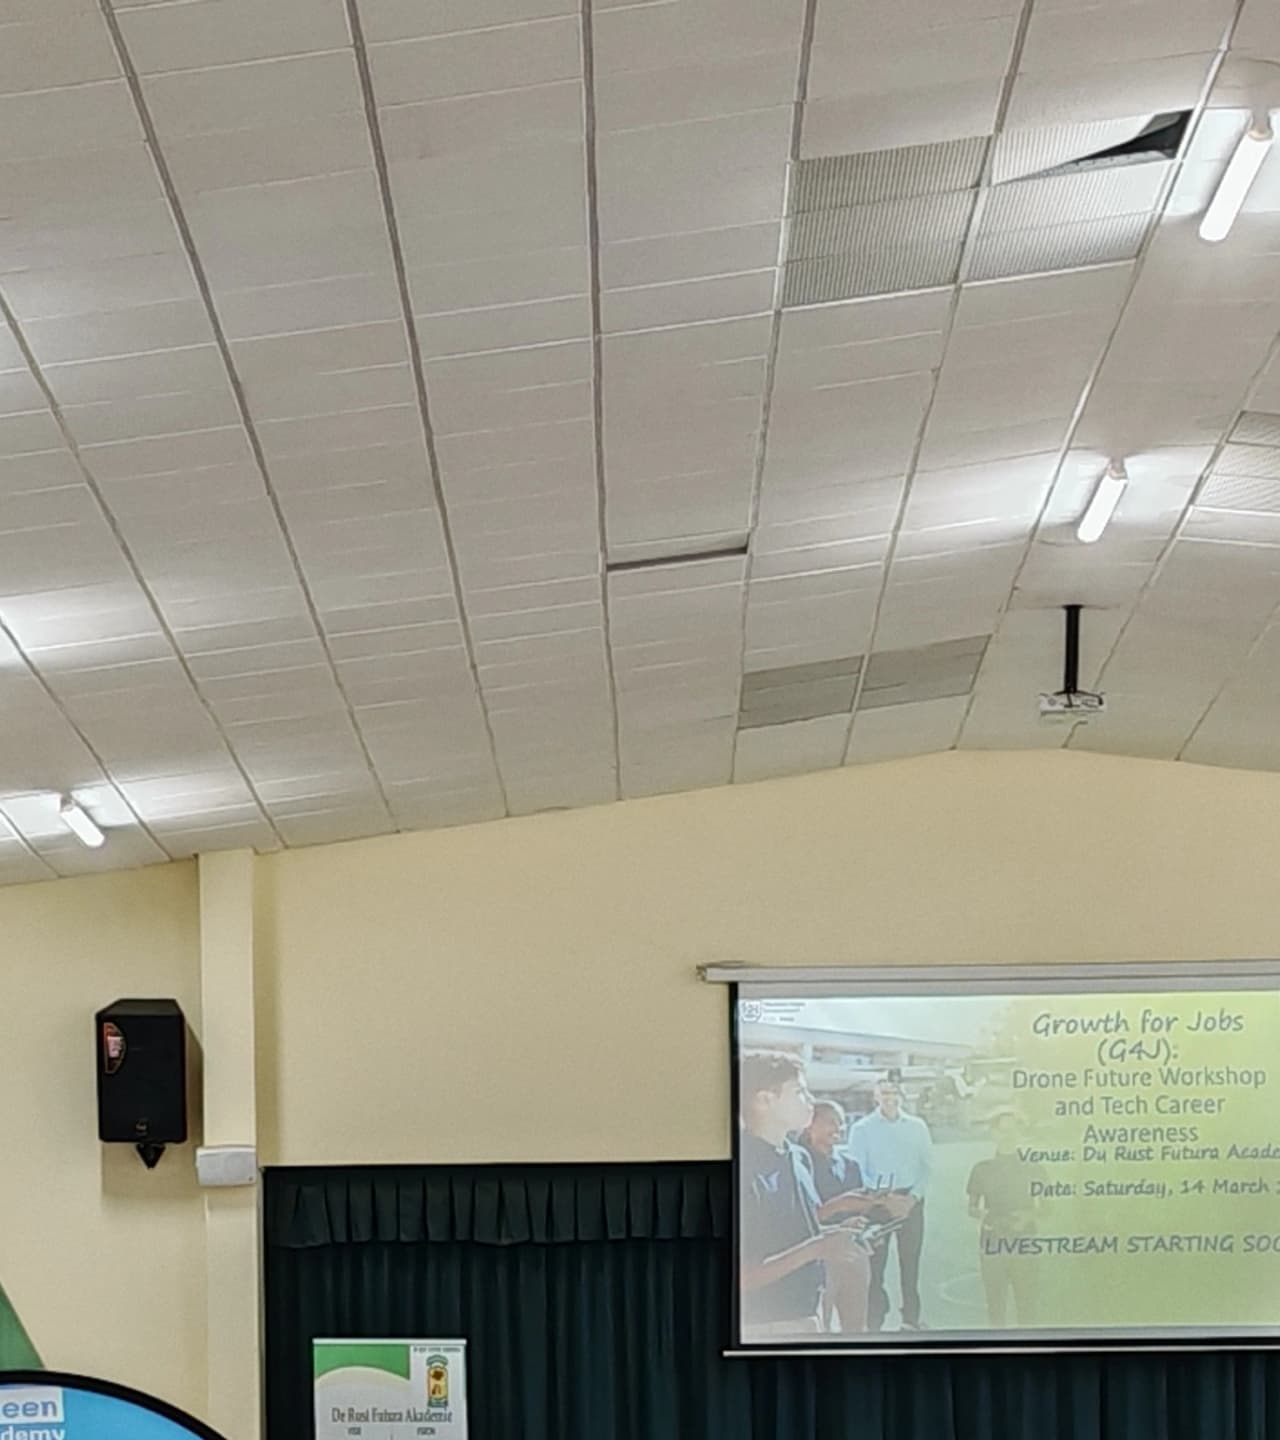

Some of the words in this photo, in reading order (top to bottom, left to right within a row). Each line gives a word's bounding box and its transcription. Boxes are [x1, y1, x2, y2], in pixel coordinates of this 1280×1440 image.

[1033, 1010, 1129, 1036] Growth
[1141, 1009, 1178, 1033] for
[1186, 1008, 1244, 1032] Jobs
[1098, 1038, 1178, 1066] (G4J):
[1013, 1069, 1077, 1088] Drone
[1084, 1068, 1152, 1087] Future
[1158, 1066, 1266, 1089] Workshop
[1055, 1097, 1094, 1116] and
[1100, 1095, 1148, 1115] Tech
[1155, 1095, 1226, 1114] Career
[1083, 1124, 1199, 1143] Awareness
[1017, 1148, 1074, 1163] Venue:
[1114, 1146, 1154, 1161] Rust
[1161, 1146, 1219, 1160] Futura
[1031, 1181, 1076, 1197] Date:
[1083, 1180, 1173, 1199] Saturday,
[1180, 1180, 1205, 1194] 14
[1213, 1177, 1269, 1194] March
[985, 1236, 1118, 1255] LIVESTREAM
[1127, 1235, 1233, 1253] STARTING
[331, 1408, 345, 1422] De
